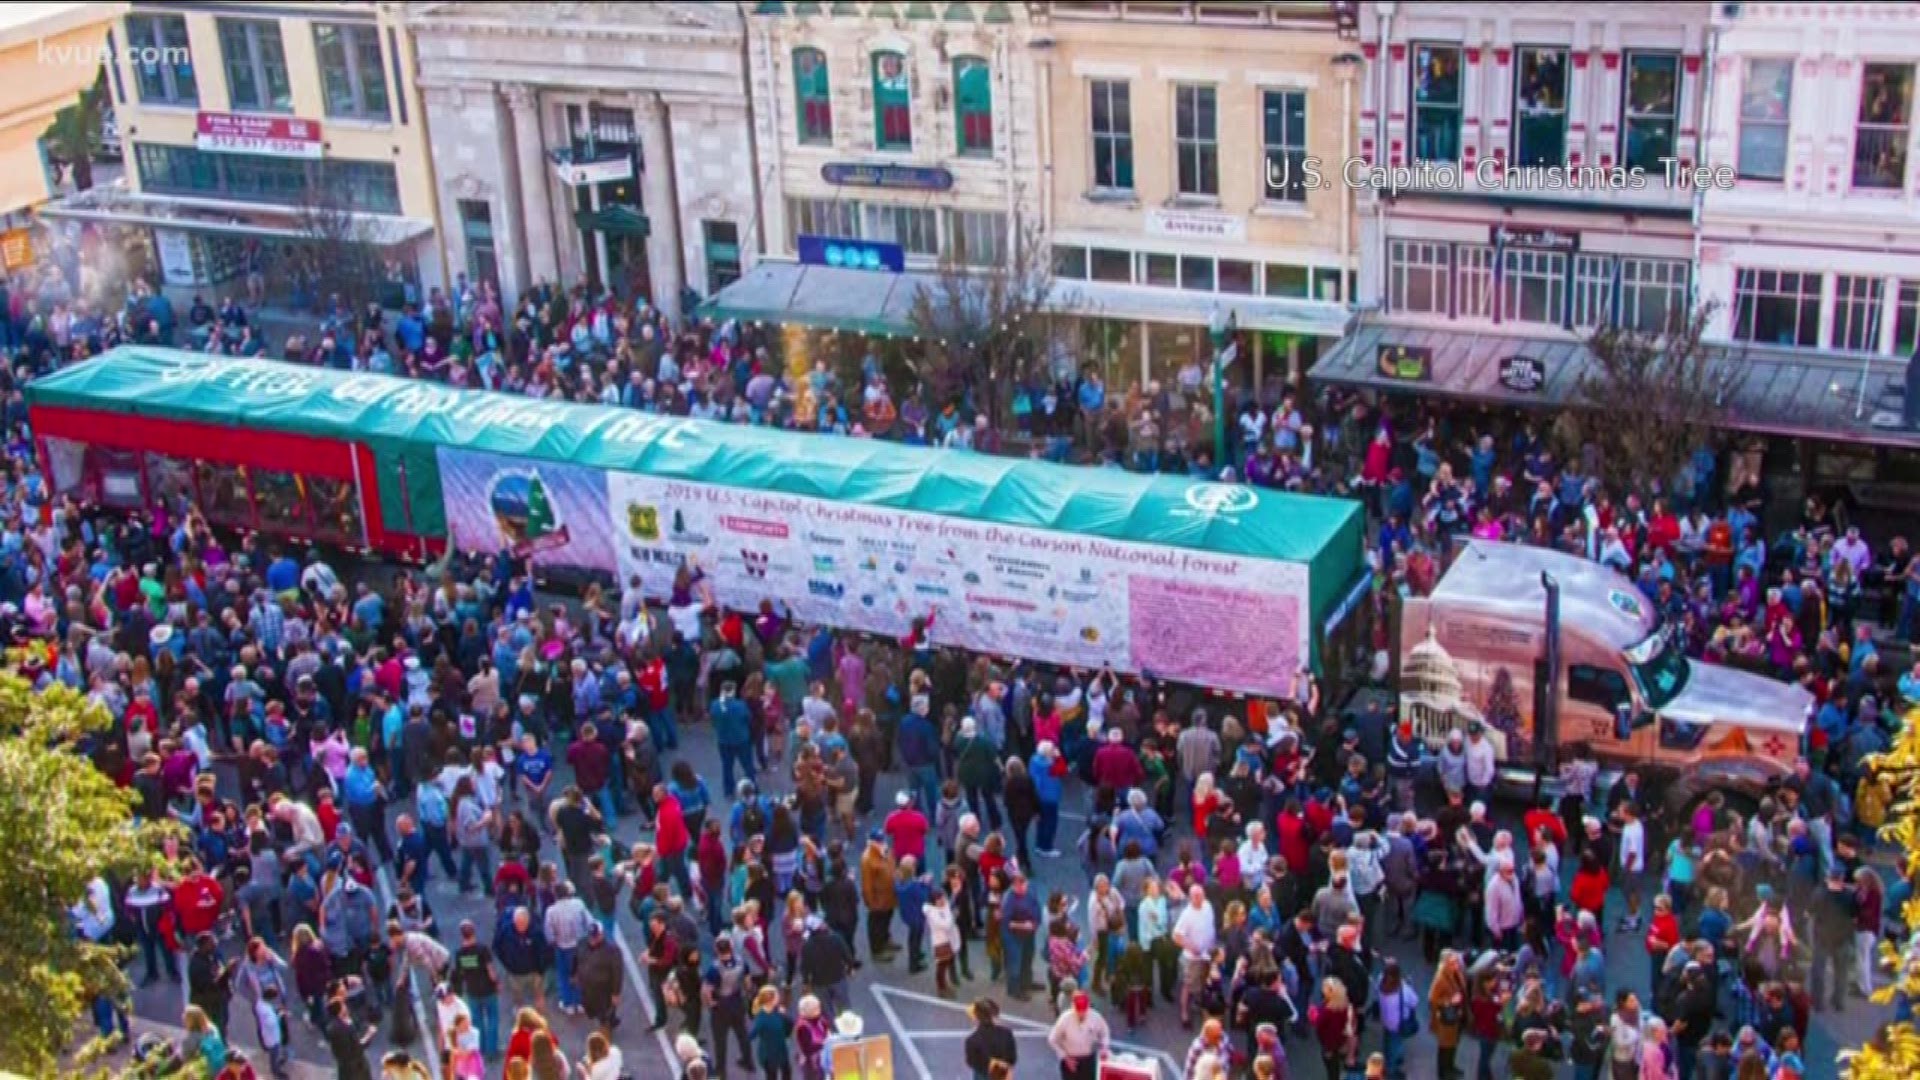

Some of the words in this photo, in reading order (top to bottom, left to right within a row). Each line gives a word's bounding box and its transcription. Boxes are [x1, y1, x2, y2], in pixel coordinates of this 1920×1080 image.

[664, 483, 701, 500] 2019
[741, 493, 801, 515] Capitol
[806, 500, 892, 527] Christmas
[898, 515, 937, 535] Tree
[938, 518, 979, 541] from
[985, 521, 1014, 543] the
[1019, 528, 1083, 555] Carson
[1089, 537, 1177, 567] National
[1182, 548, 1241, 576] Forest
